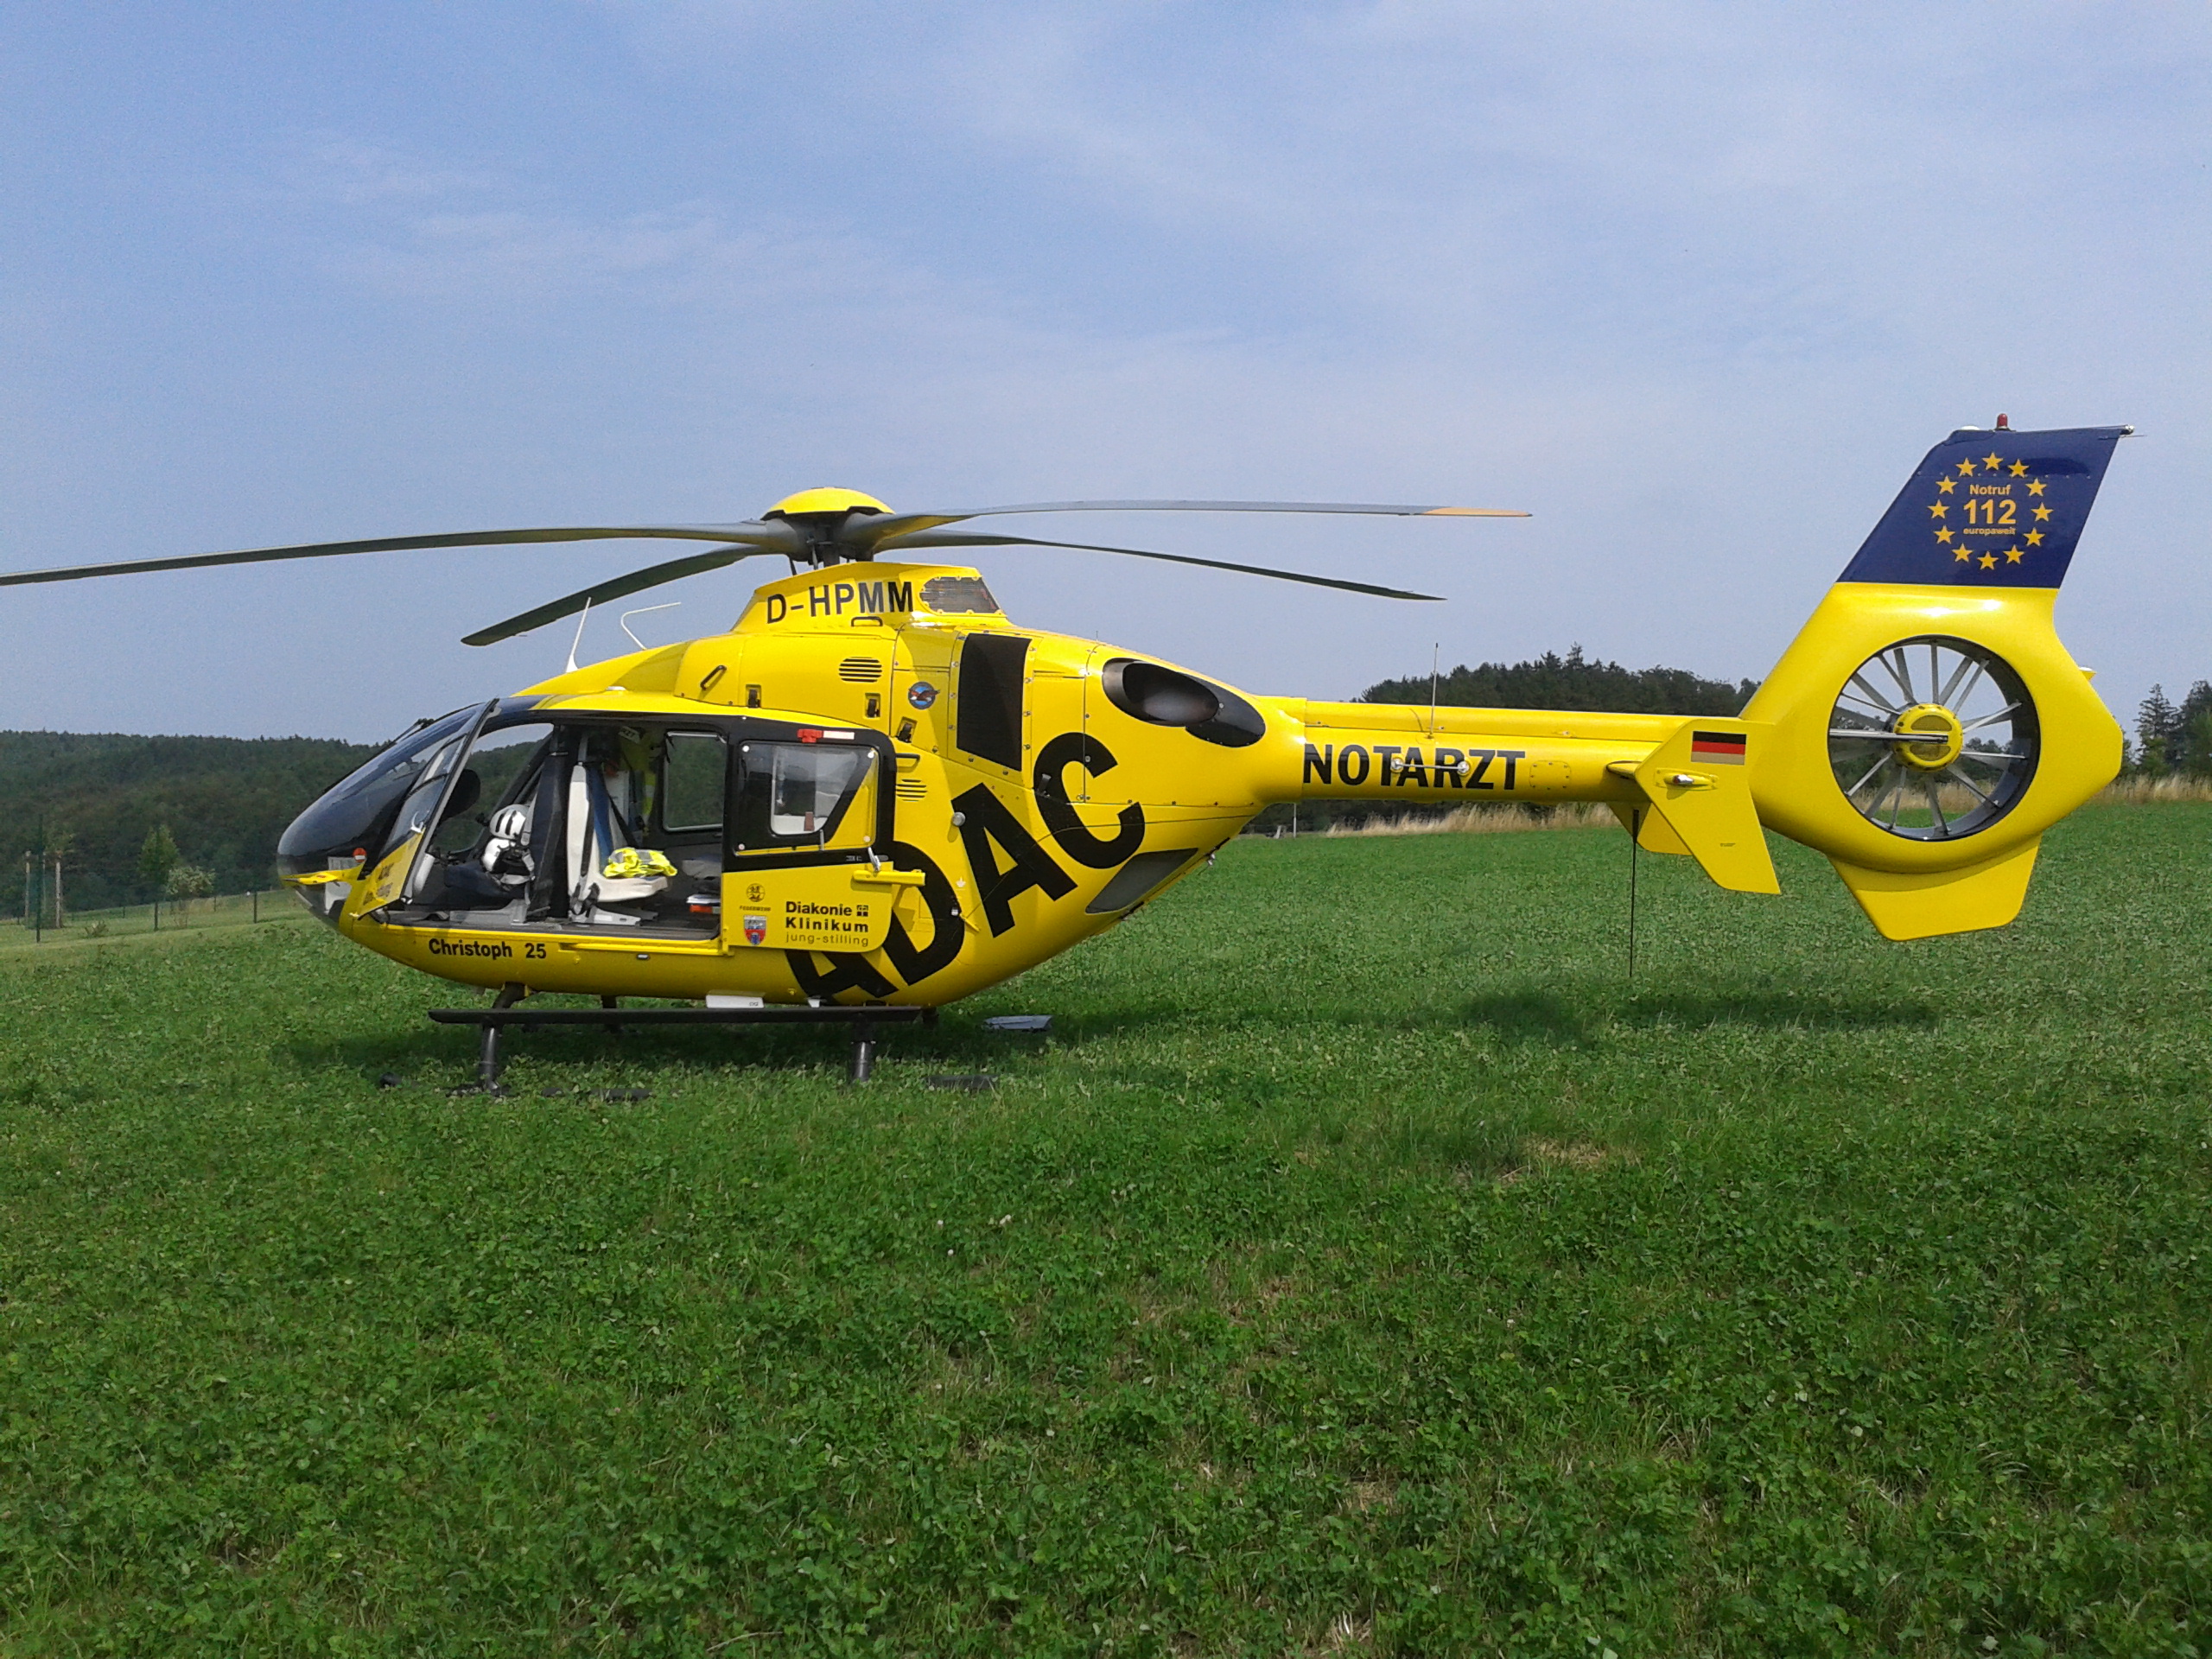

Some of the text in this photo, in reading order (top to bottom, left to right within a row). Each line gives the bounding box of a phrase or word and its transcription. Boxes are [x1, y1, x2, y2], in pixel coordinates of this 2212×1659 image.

[1970, 484, 2012, 495] Notruf
[1963, 499, 2017, 524] 112
[767, 582, 914, 624] D-HPMM
[1302, 743, 1526, 790] NOTARZT
[785, 901, 853, 917] Diakonie
[785, 917, 868, 932] Klinikum
[429, 938, 547, 960] Christoph 25
[785, 931, 868, 948] jung-stilling
